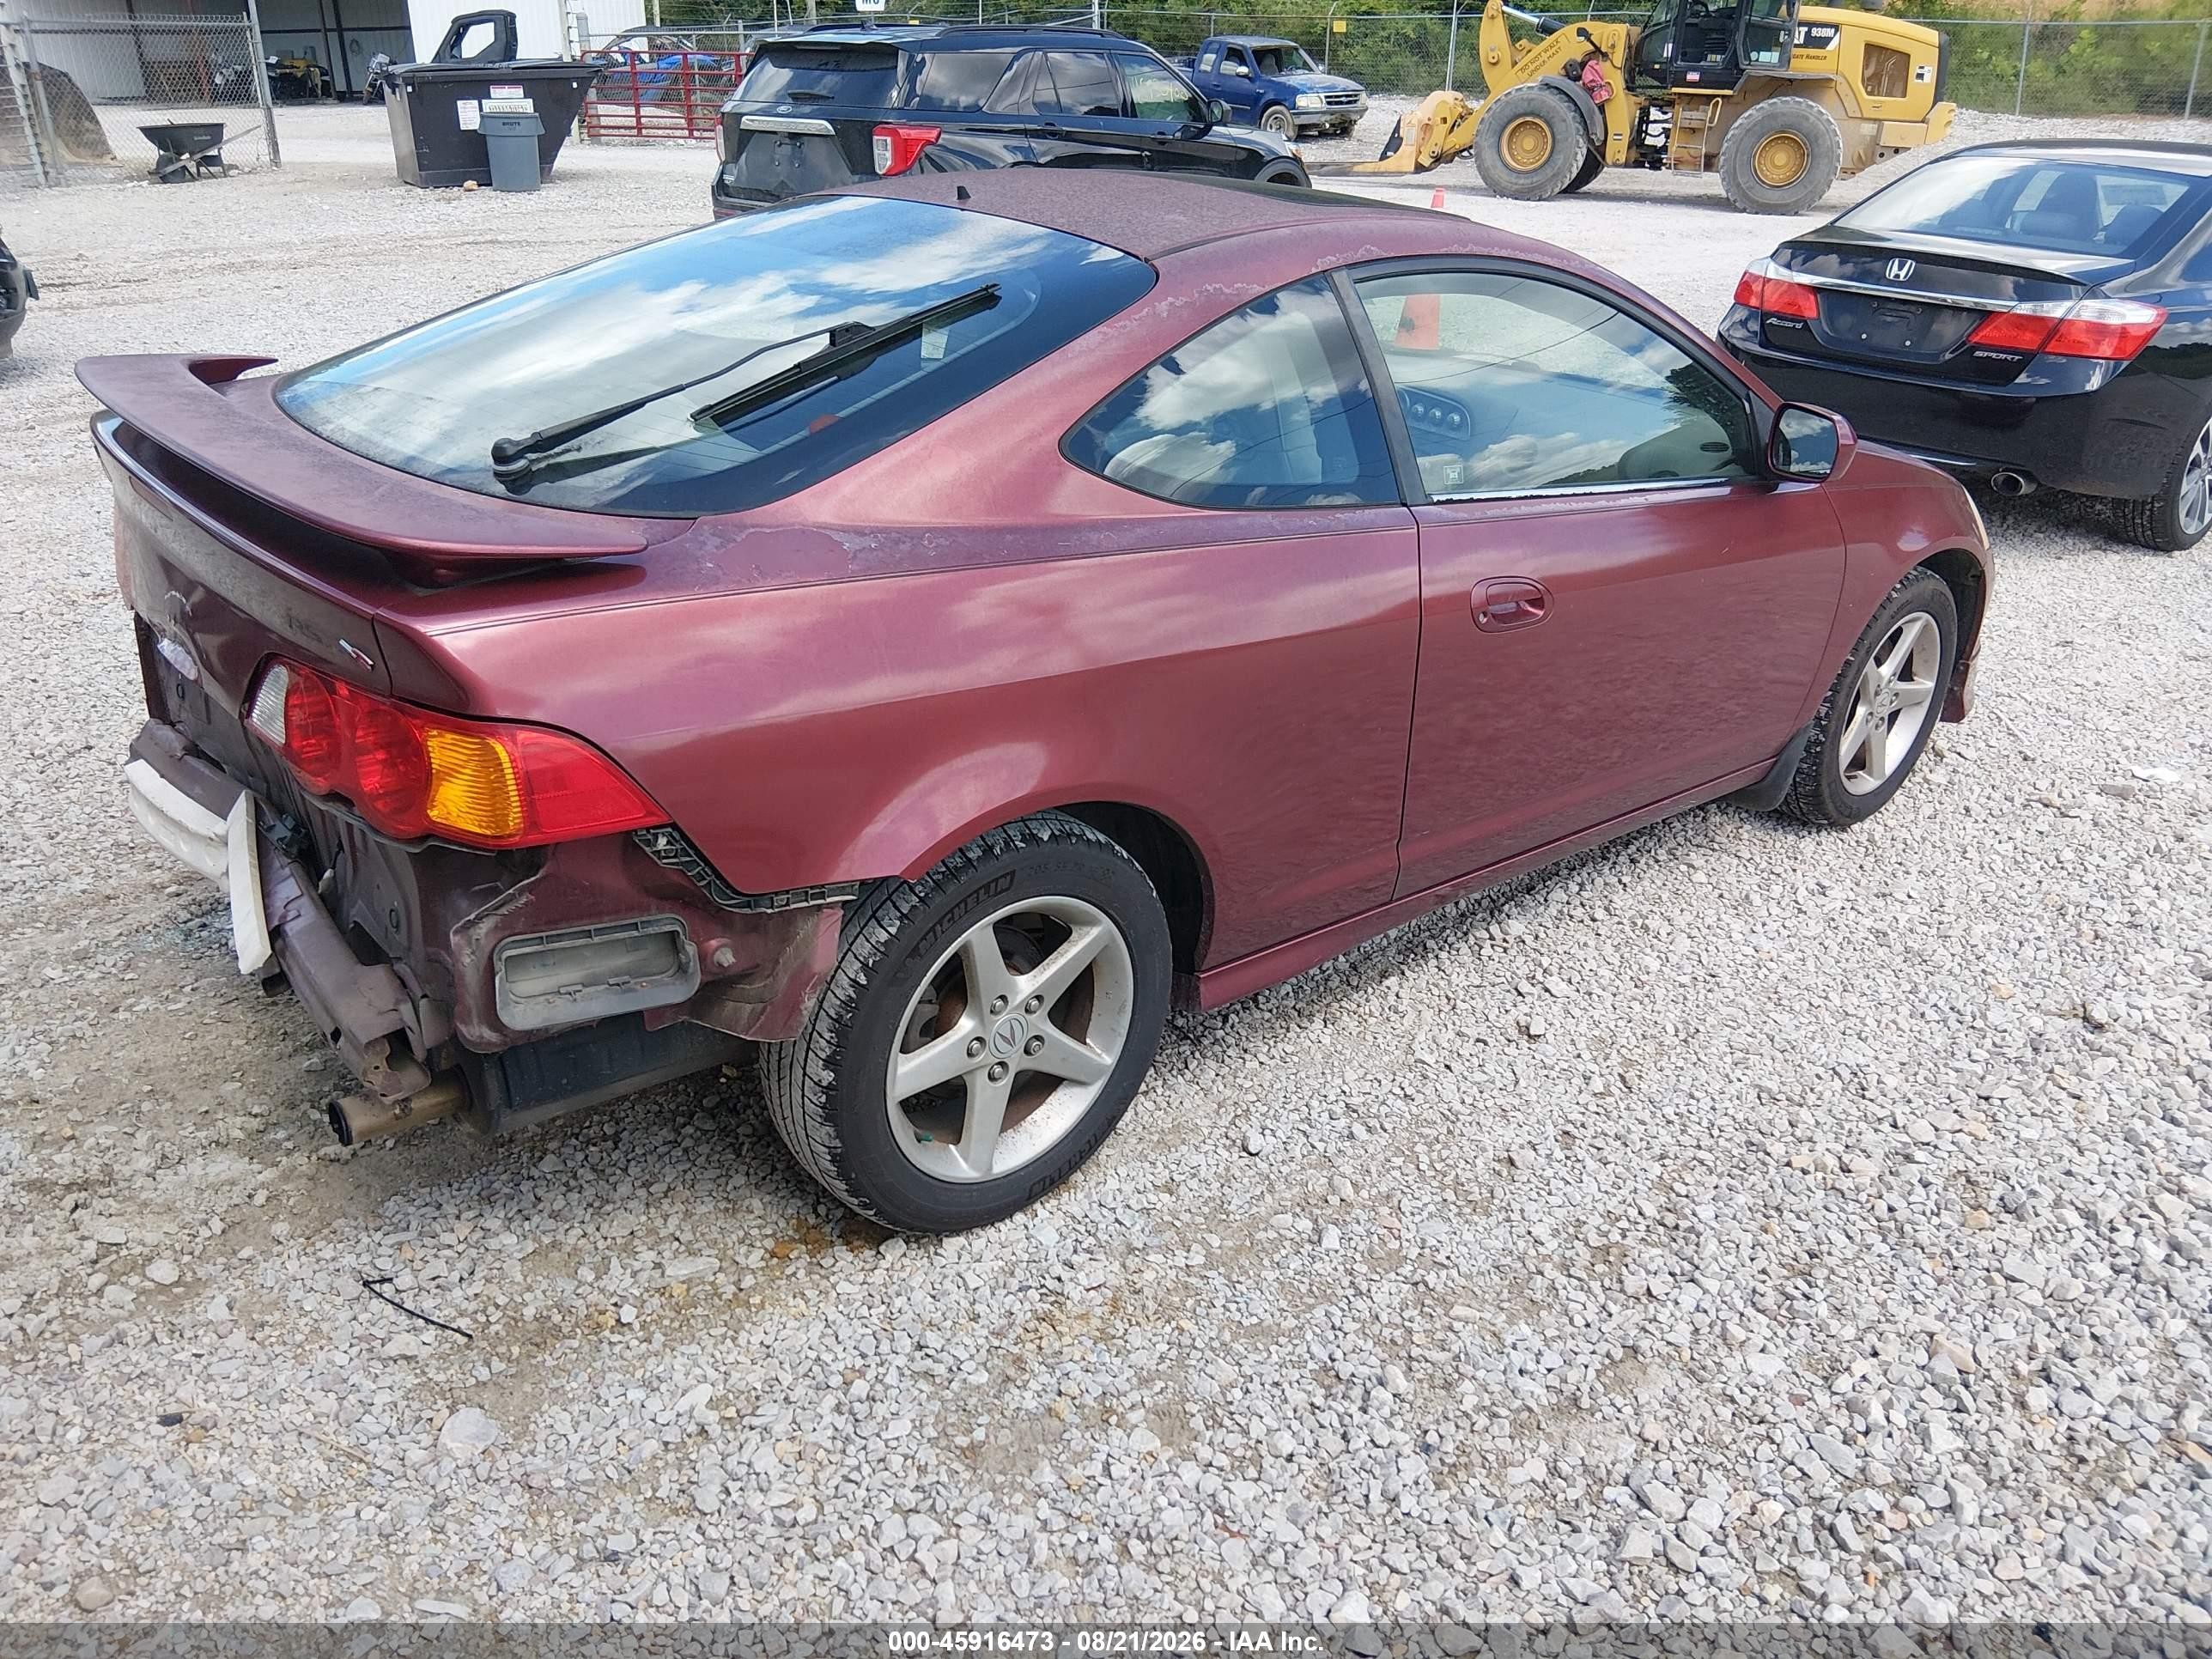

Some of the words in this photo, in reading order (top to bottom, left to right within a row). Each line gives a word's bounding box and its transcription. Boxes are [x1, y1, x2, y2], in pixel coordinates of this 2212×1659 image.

[1811, 27, 1835, 38] 938M
[1520, 64, 1530, 74] DO
[1530, 52, 1543, 65] NOT
[1542, 38, 1560, 54] WALK
[1528, 61, 1547, 76] UNDER
[1547, 46, 1562, 61] MAST
[1765, 318, 1804, 329] Accord
[1972, 350, 2024, 362] SPORT
[916, 871, 1016, 955] MICHELIN
